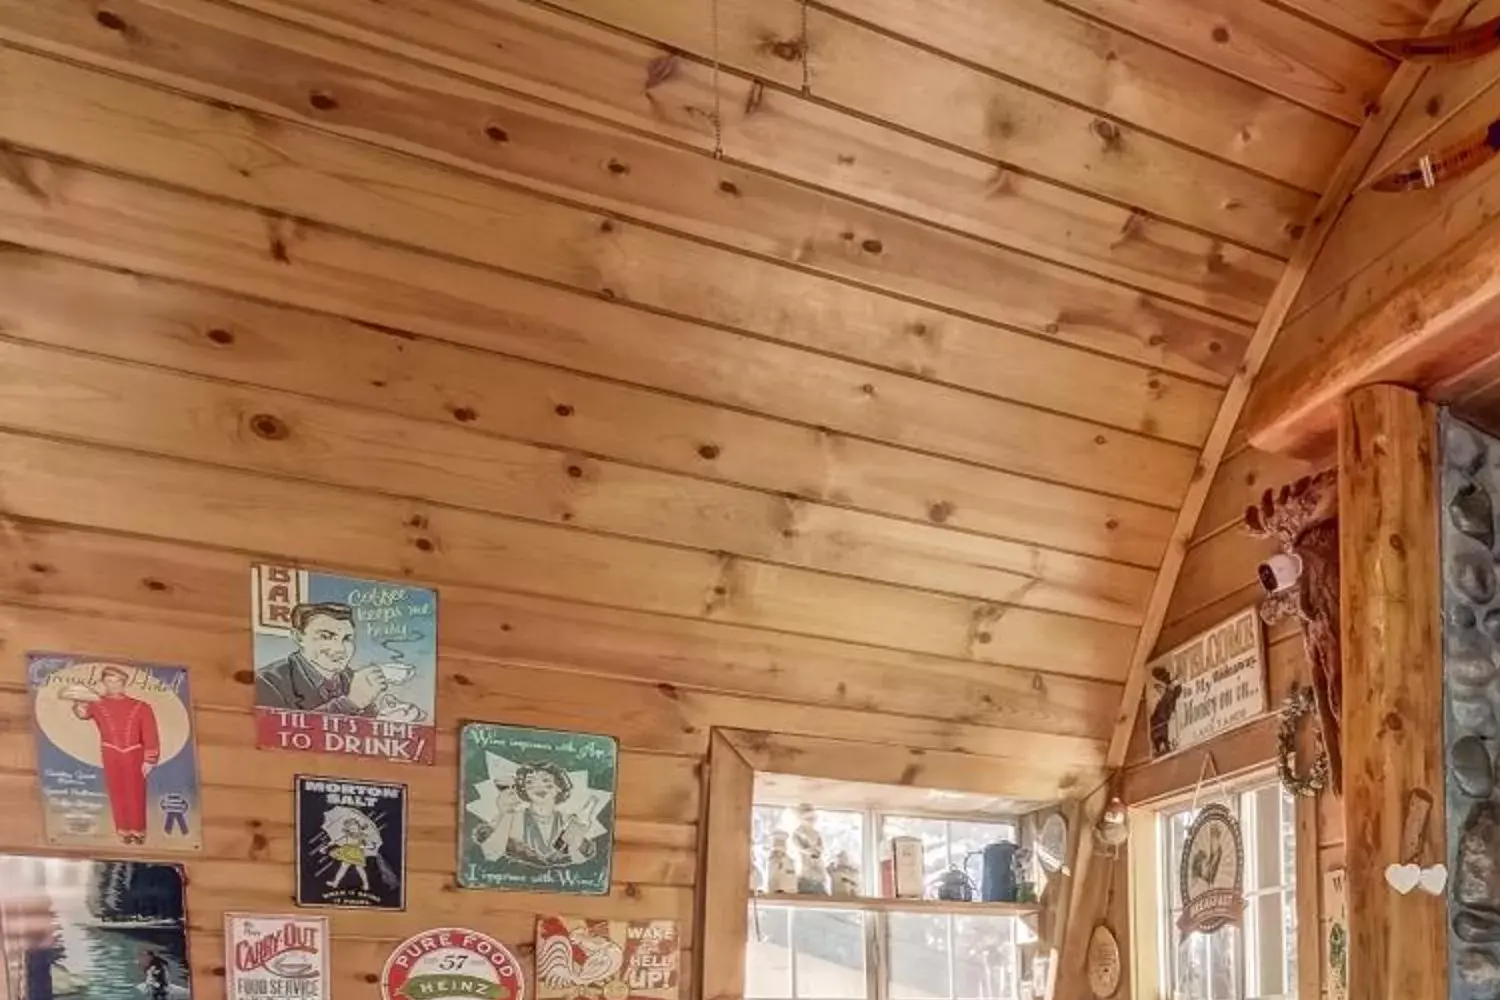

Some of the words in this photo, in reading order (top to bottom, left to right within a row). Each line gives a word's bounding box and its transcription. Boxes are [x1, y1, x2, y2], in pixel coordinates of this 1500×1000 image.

[322, 714, 358, 733] IT'S
[372, 721, 416, 739] TIME
[277, 732, 312, 749] TO
[325, 733, 425, 761] DRINK!
[305, 781, 402, 797] MORTON
[326, 794, 378, 807] SALT
[627, 927, 674, 940] WAKE
[395, 933, 452, 968] PURE
[463, 935, 513, 977] FOOD
[439, 955, 468, 970] 57
[629, 953, 673, 967] HELL
[238, 979, 267, 994] FOOD
[270, 978, 320, 996] SERVICE
[419, 981, 489, 994] HEINZ
